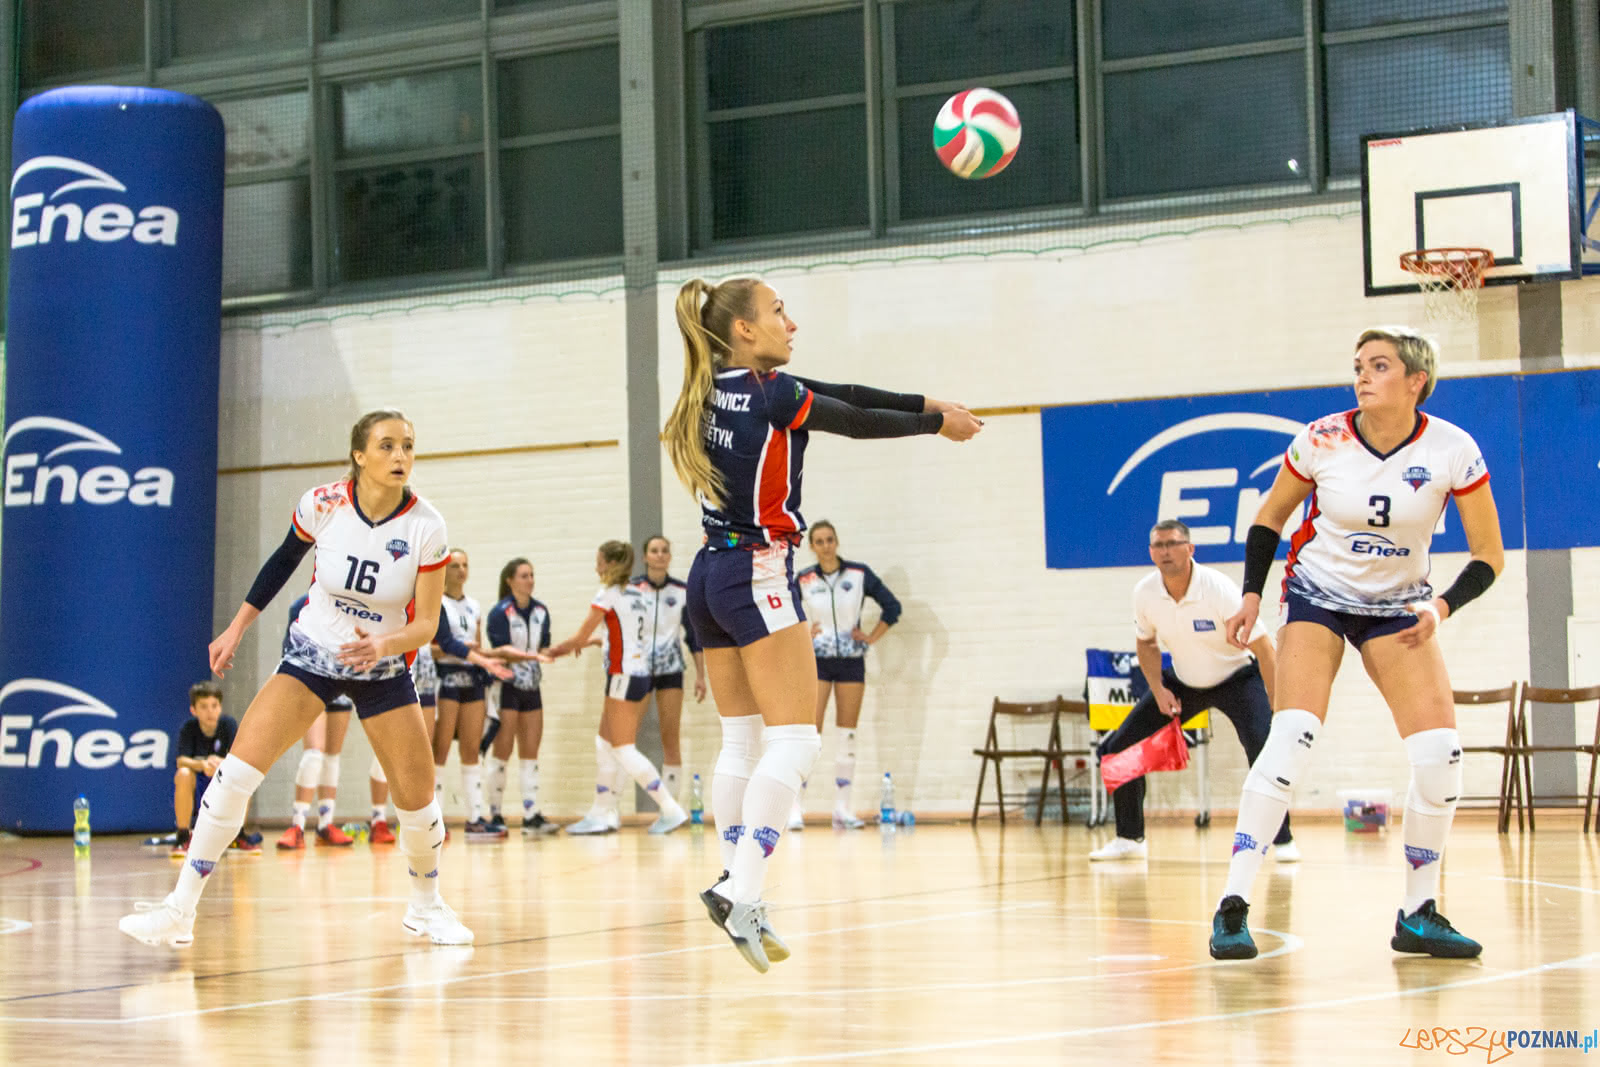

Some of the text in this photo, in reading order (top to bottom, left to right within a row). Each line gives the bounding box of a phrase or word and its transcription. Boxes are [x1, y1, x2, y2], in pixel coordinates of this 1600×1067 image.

[11, 193, 179, 249] Enea
[4, 453, 175, 507] Enea
[1368, 495, 1391, 528] 3
[1351, 540, 1410, 557] Enea
[344, 555, 380, 595] 16
[334, 600, 383, 622] Enea
[766, 595, 782, 610] 6
[0, 715, 170, 769] Enea
